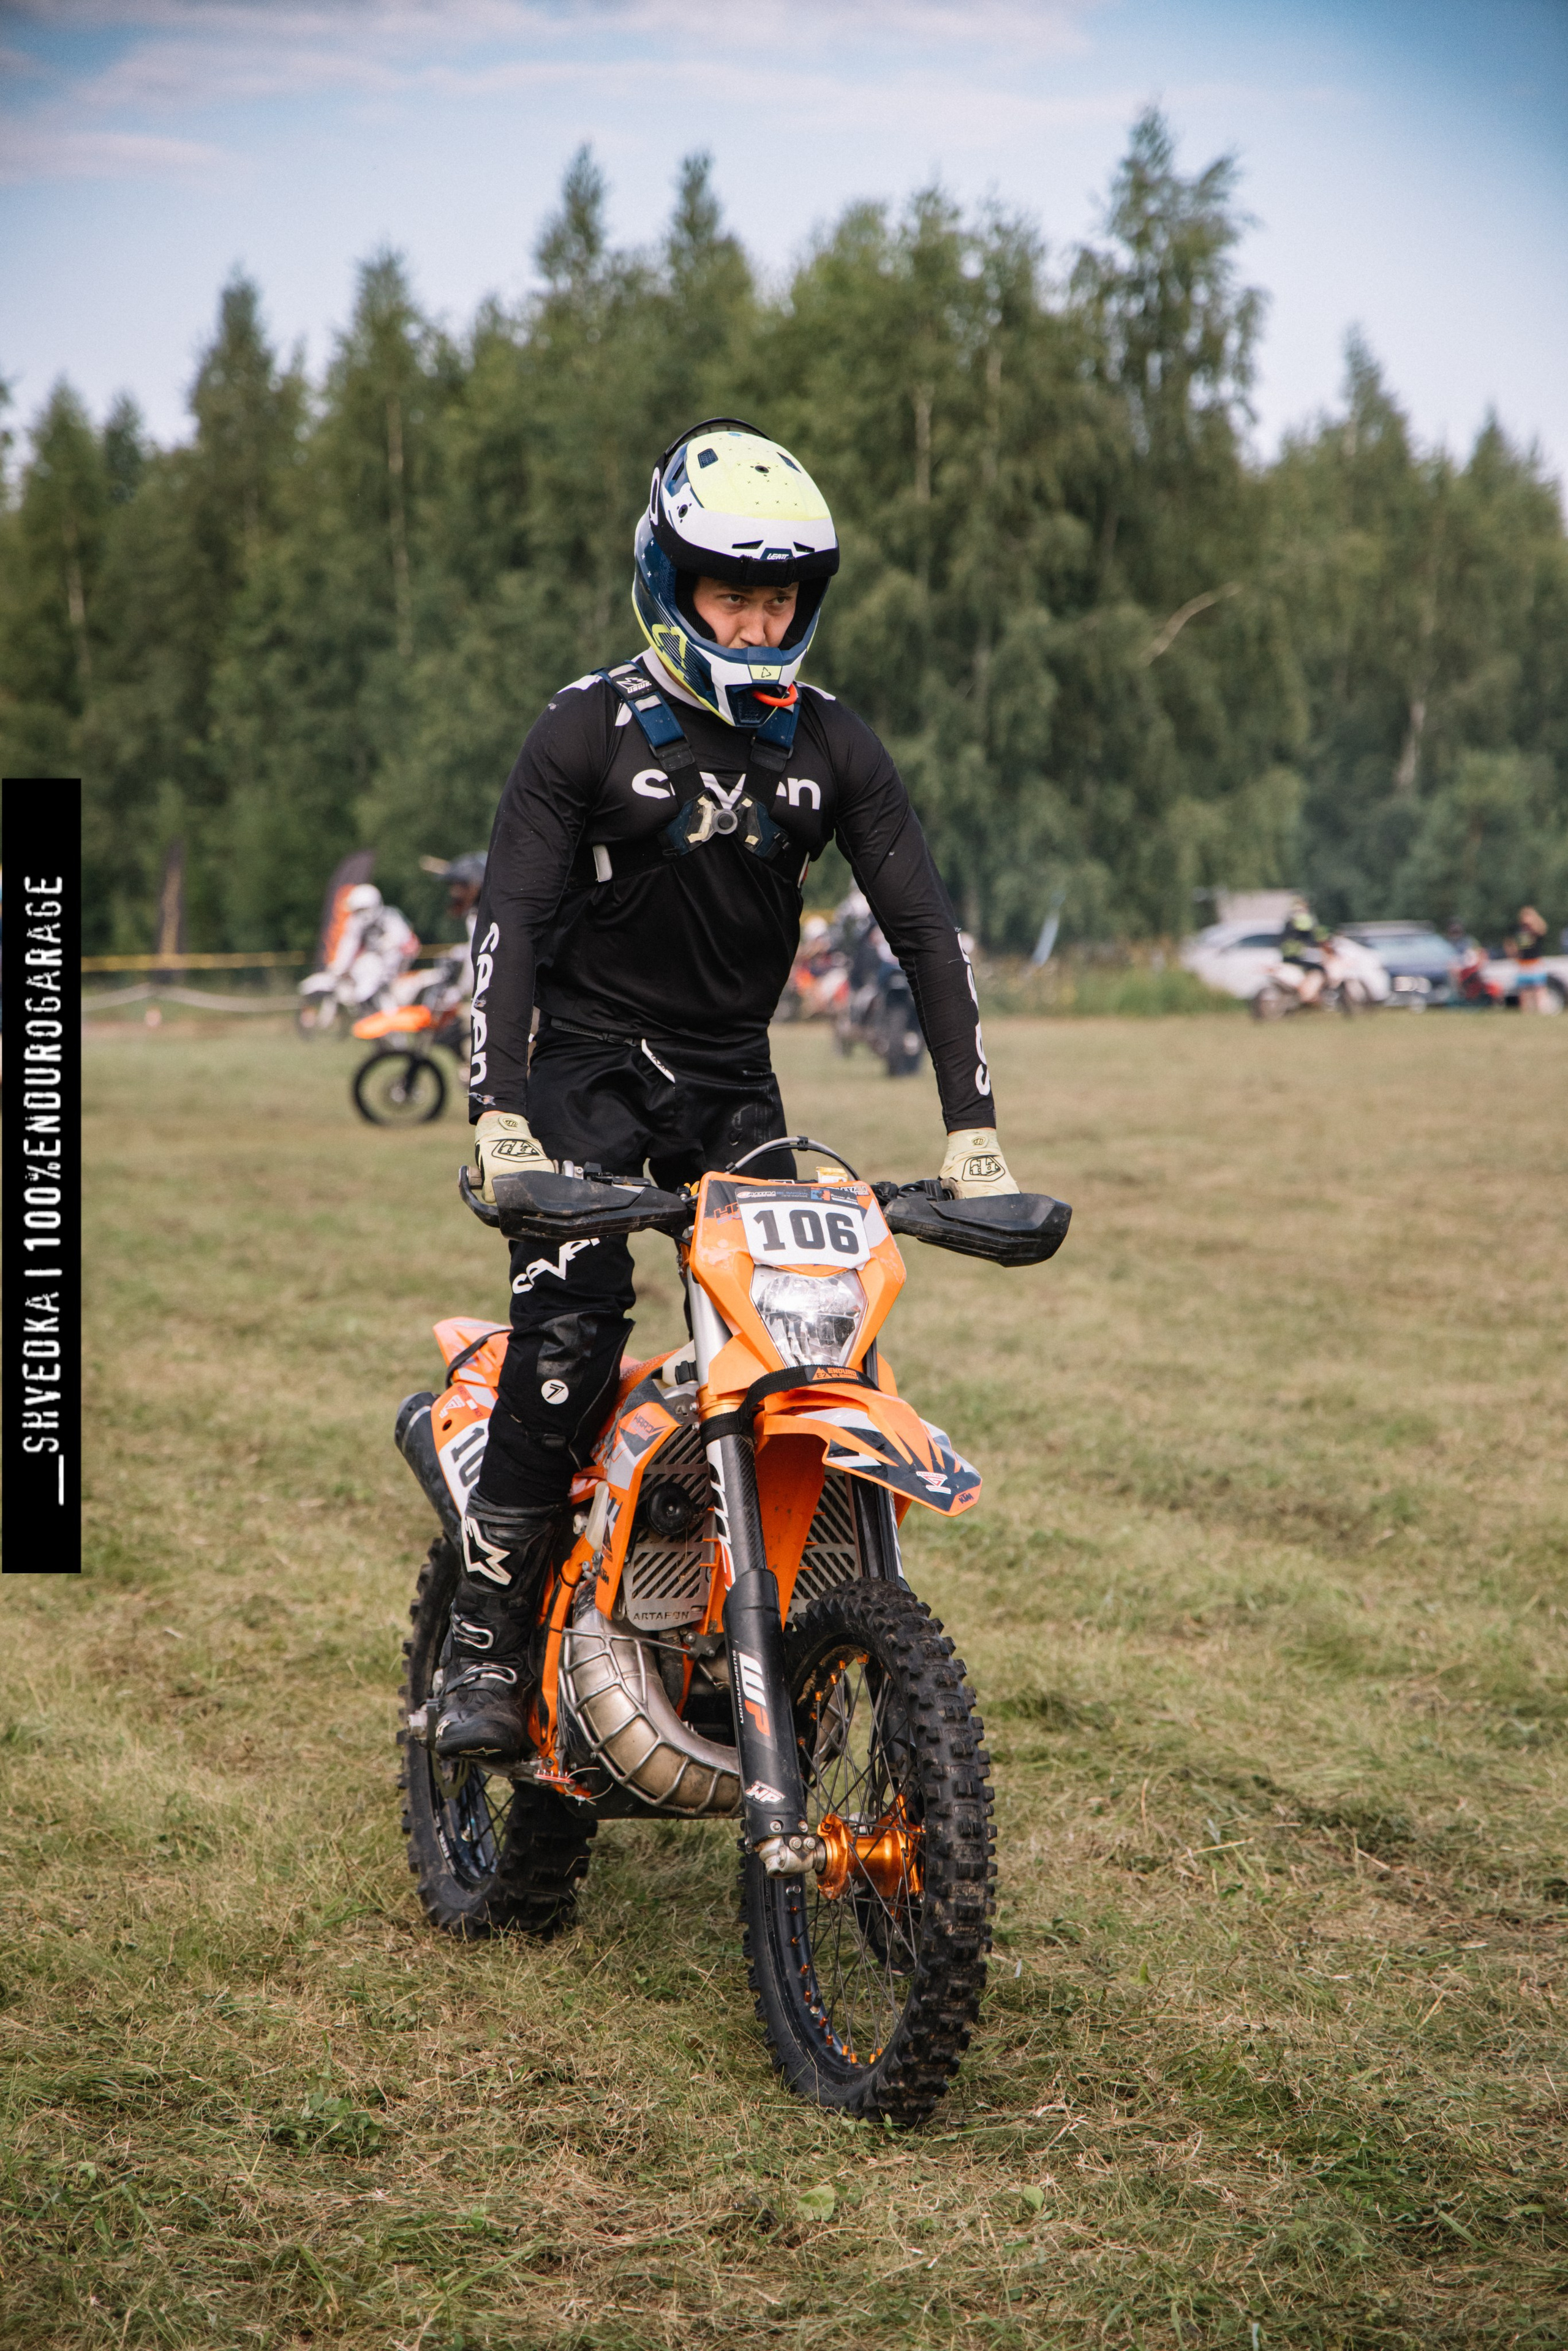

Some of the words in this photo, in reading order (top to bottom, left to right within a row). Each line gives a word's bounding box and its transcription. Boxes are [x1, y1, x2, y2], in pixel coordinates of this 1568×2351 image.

[631, 768, 821, 810] svn
[753, 1209, 859, 1255] 106
[827, 1367, 858, 1377] ENDURO
[958, 1492, 974, 1504] KTM
[632, 1611, 690, 1621] ARTAFON
[732, 1649, 744, 1724] SUSPENSION
[739, 1651, 771, 1737] WP
[745, 1784, 782, 1803] WP
[755, 1779, 786, 1799] SUSPENSION
